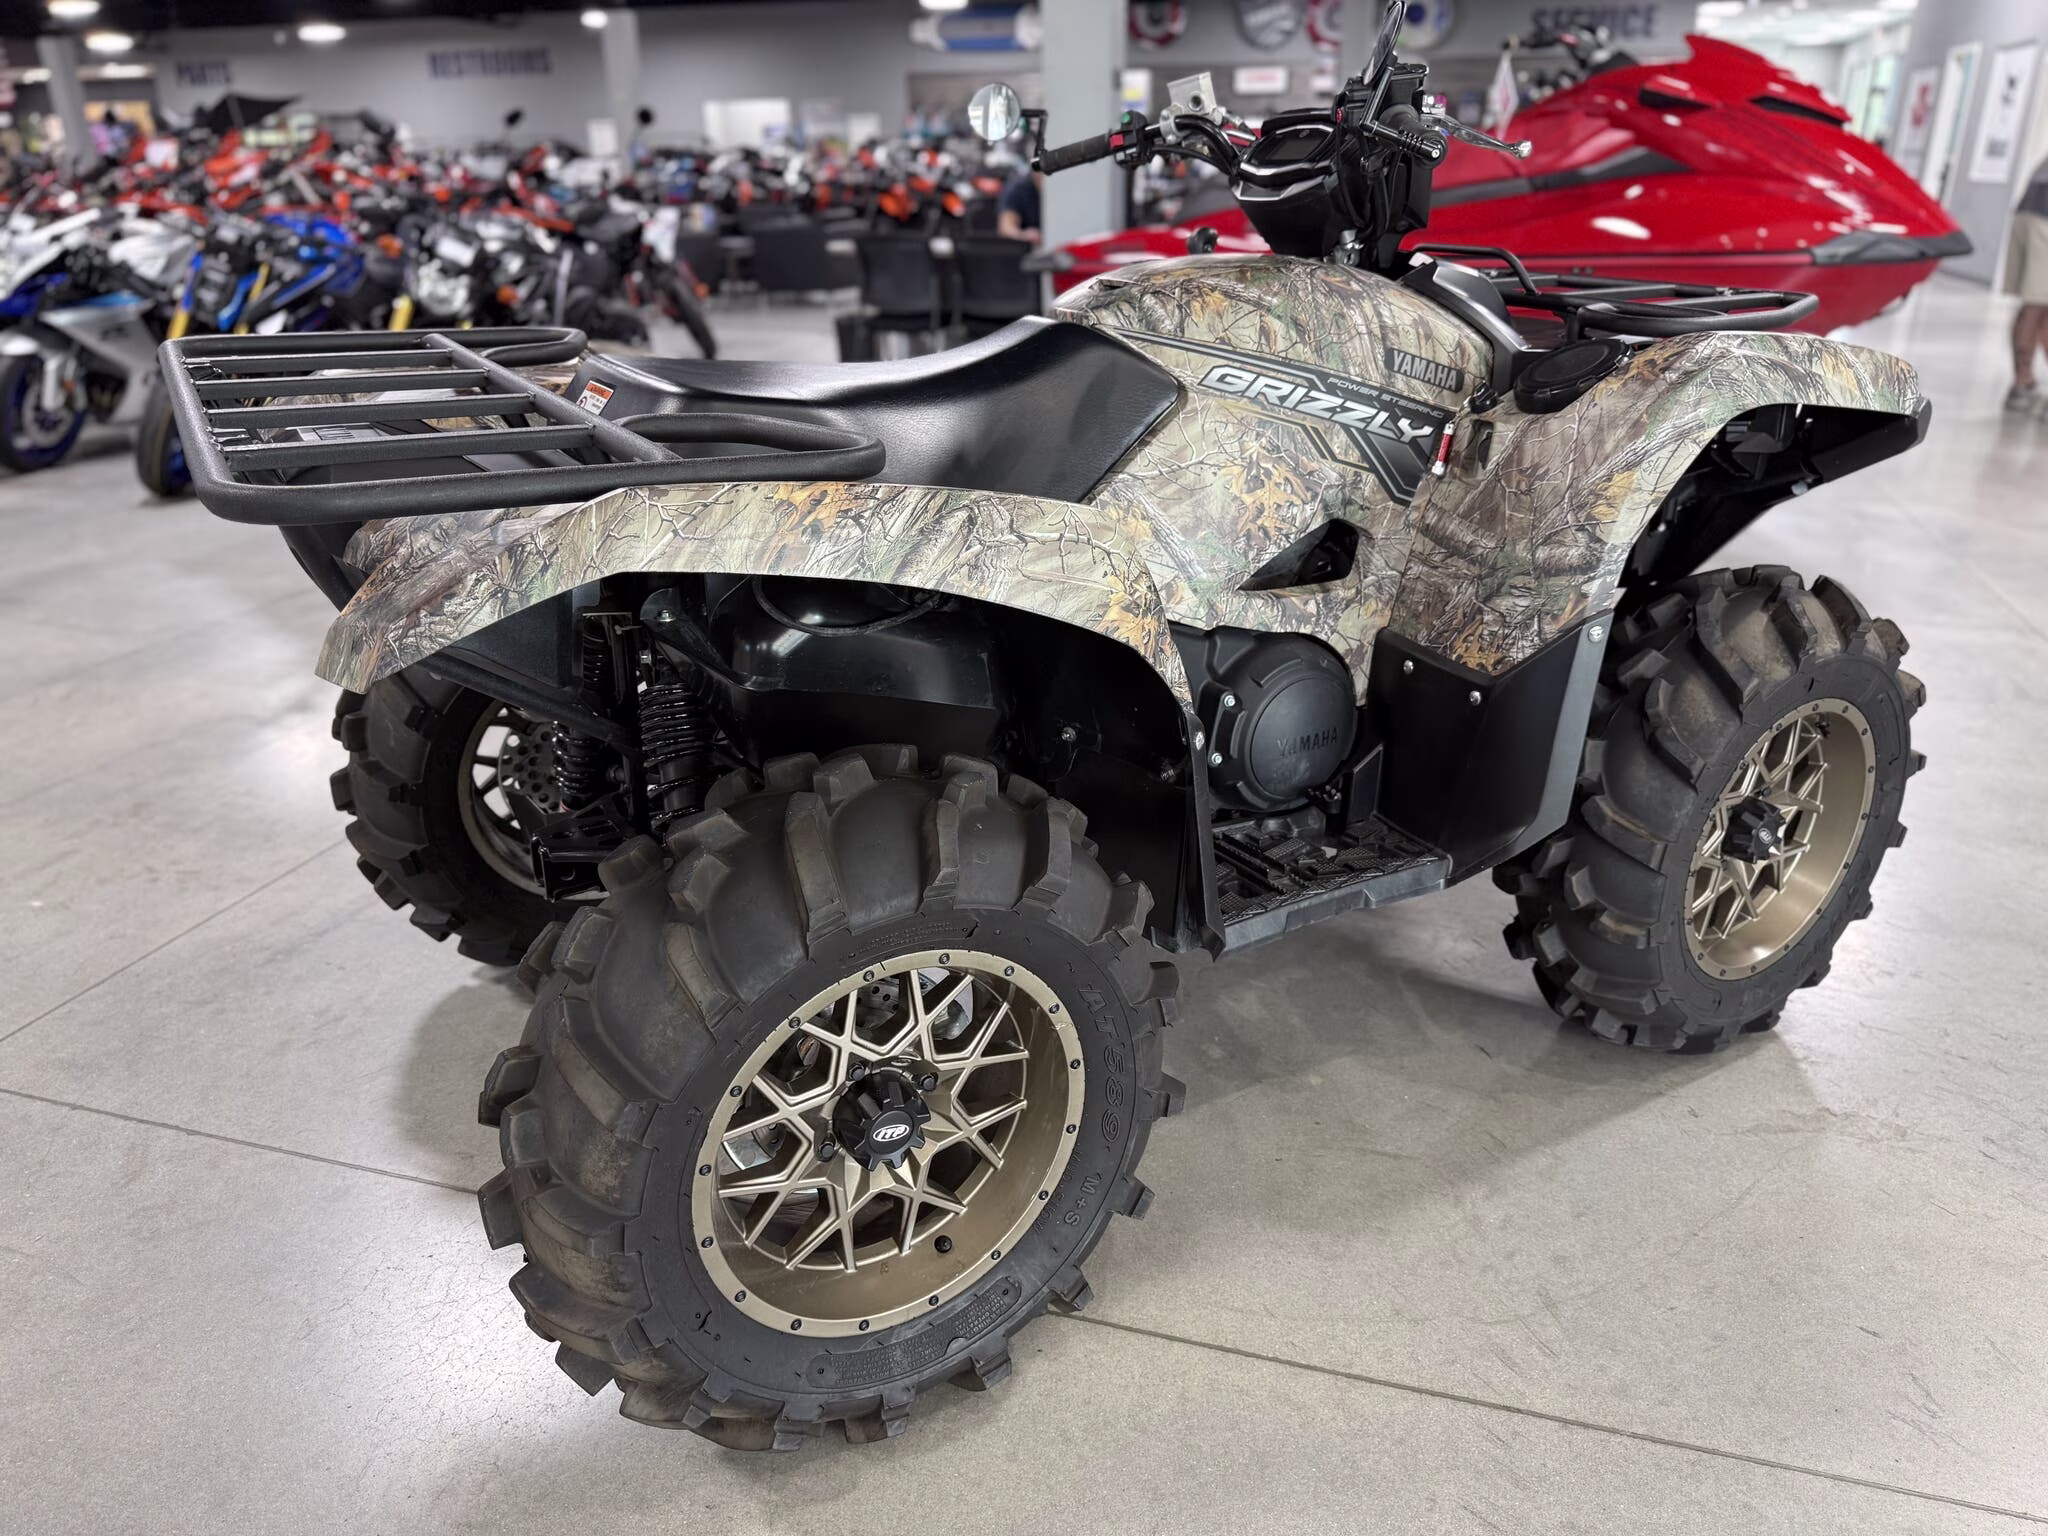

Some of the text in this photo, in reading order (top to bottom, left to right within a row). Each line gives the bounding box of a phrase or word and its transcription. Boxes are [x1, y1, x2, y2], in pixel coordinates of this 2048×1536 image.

[1393, 350, 1457, 391] YAMAHA
[1198, 365, 1435, 444] GRIZZLY
[1327, 377, 1445, 419] POWER STEERING
[1277, 727, 1337, 757] YAMAHA
[875, 1125, 907, 1140] ITP
